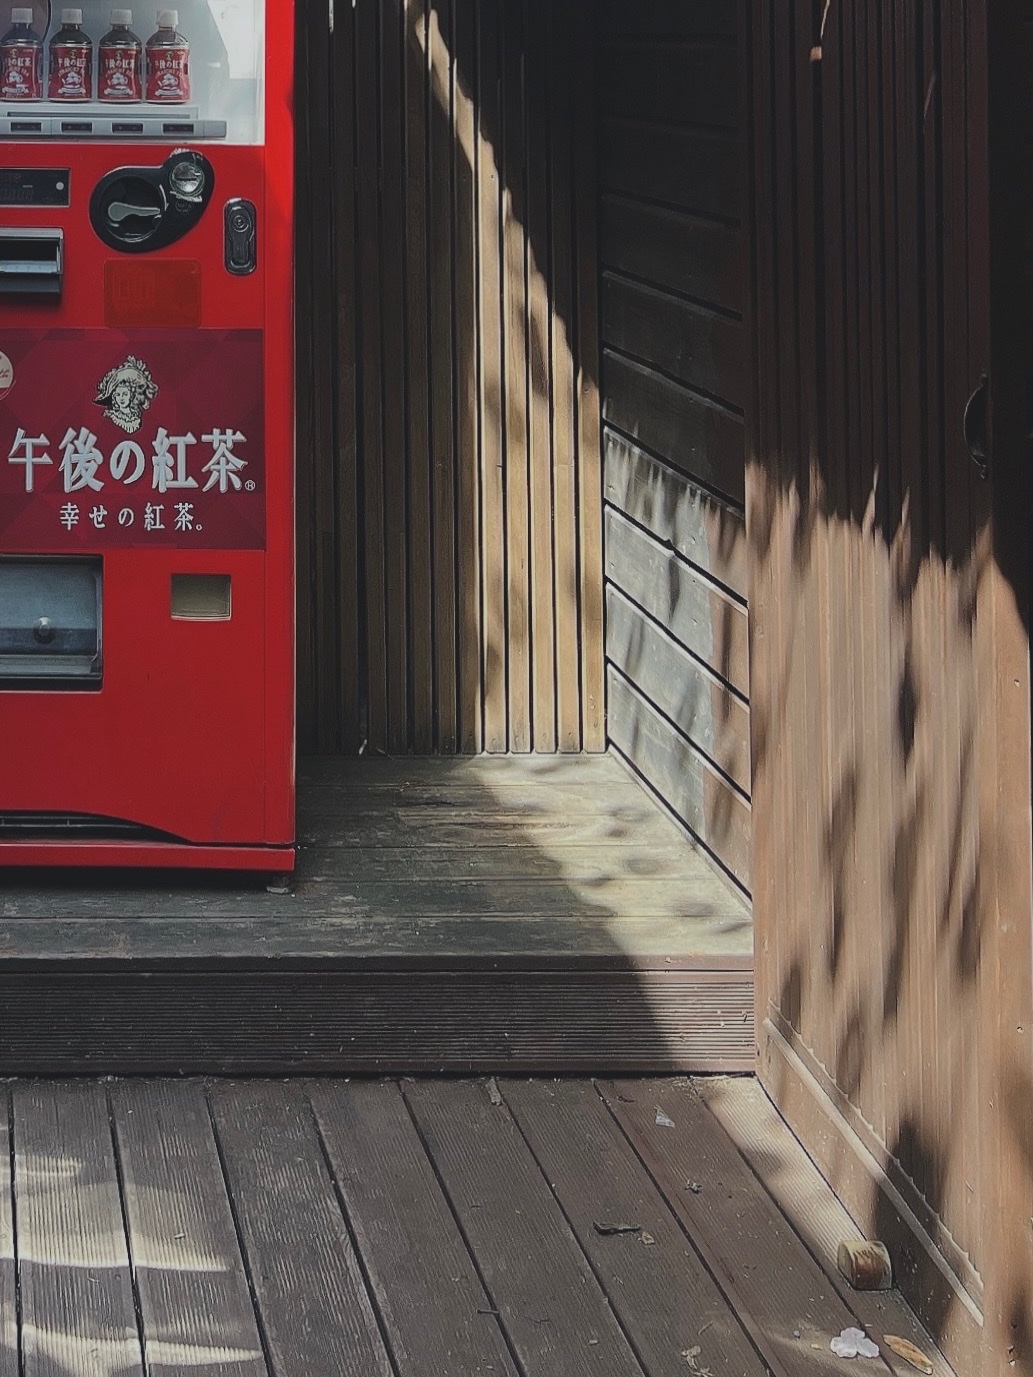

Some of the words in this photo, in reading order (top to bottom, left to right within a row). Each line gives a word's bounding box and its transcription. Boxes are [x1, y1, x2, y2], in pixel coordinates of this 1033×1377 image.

[59, 502, 203, 532] 幸せの紅茶。
